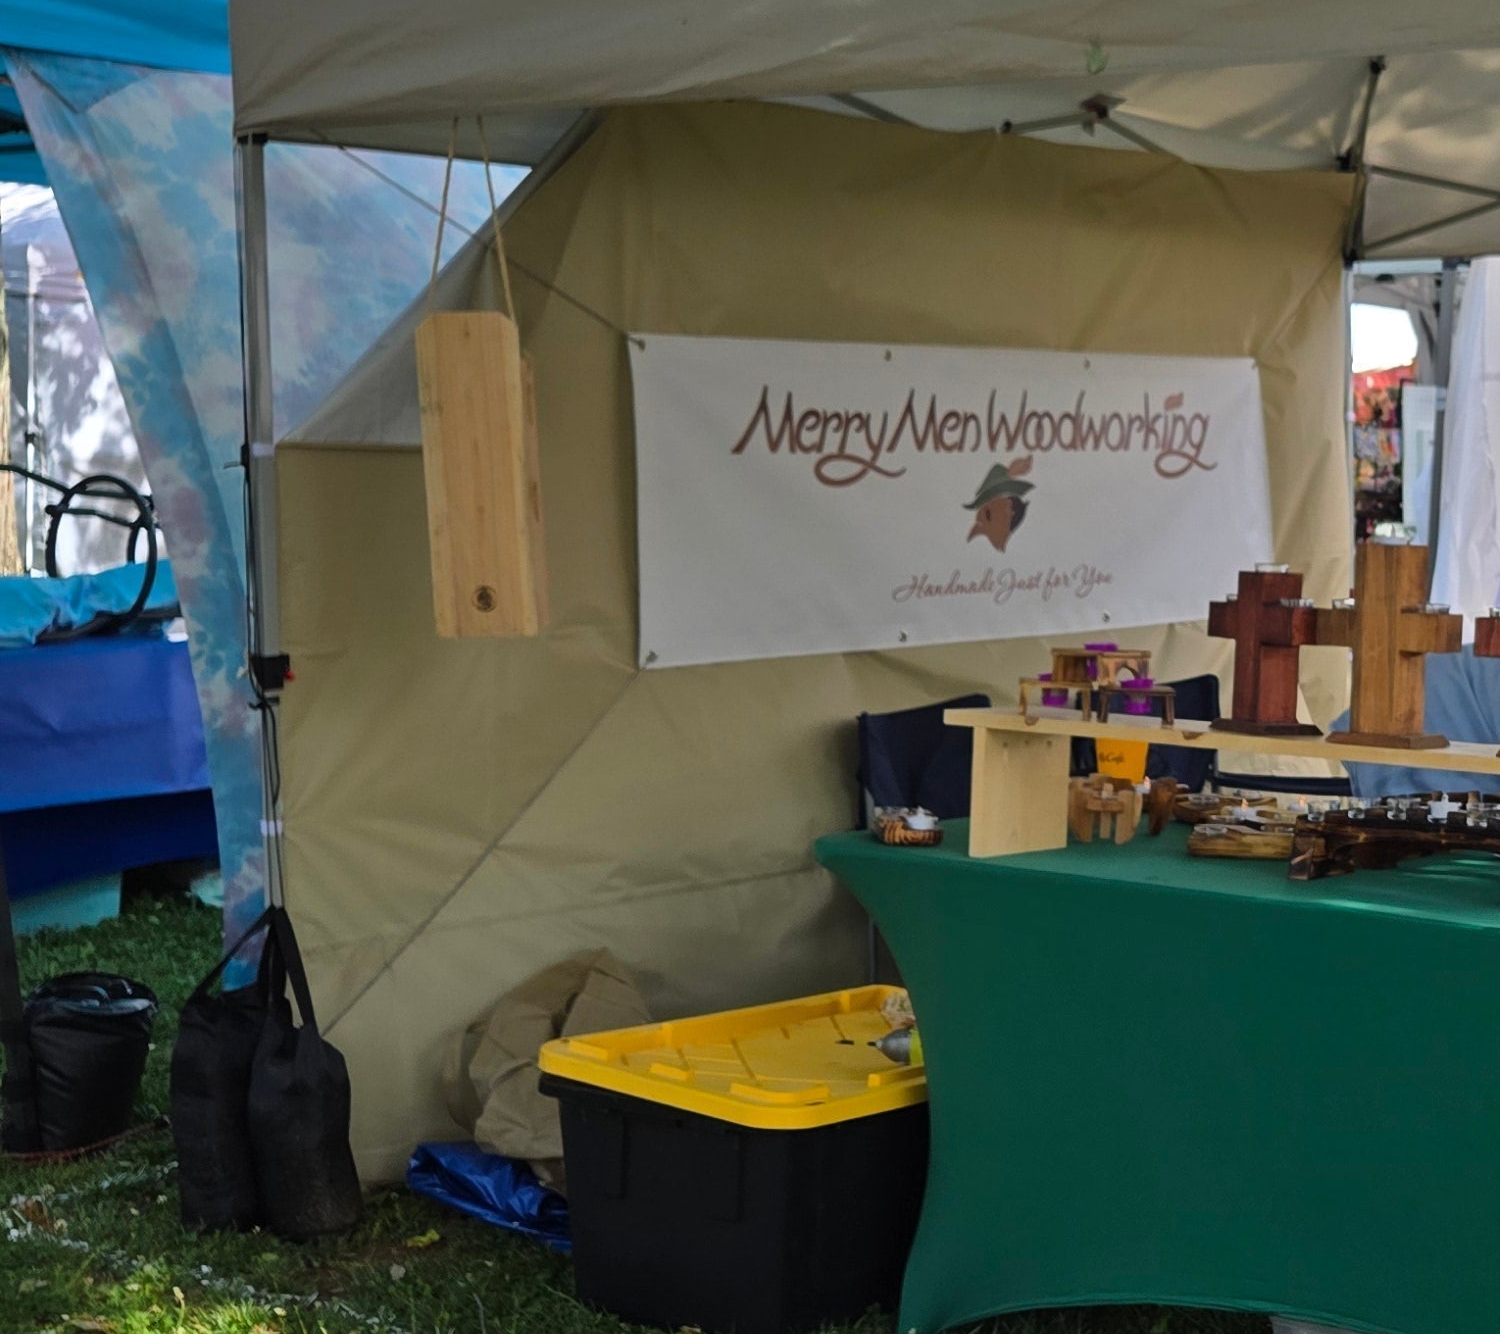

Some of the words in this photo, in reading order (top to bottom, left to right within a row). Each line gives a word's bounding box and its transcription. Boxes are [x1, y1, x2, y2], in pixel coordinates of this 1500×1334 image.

[731, 384, 907, 487] Merry
[886, 387, 982, 453] Men
[987, 388, 1218, 479] Woodworking
[891, 569, 995, 603] Handmade
[993, 568, 1043, 604] Just
[1041, 567, 1070, 601] for
[1072, 564, 1113, 598] You
